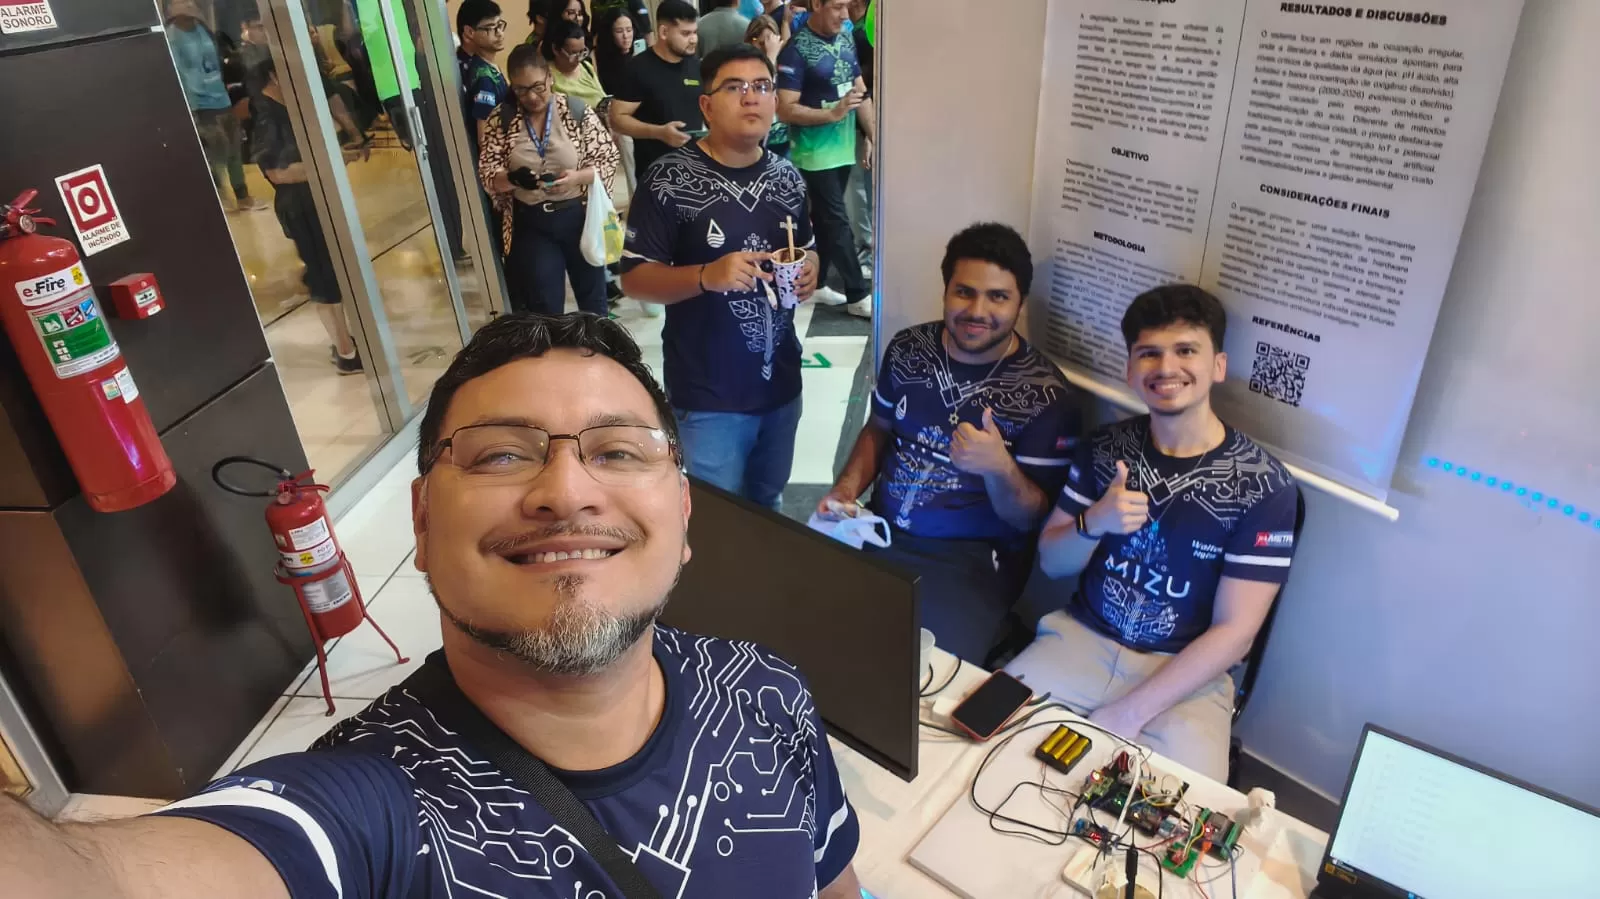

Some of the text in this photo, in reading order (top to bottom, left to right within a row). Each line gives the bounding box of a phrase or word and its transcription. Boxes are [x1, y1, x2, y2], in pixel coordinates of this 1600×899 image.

[1, 4, 48, 17] ALARME
[3, 15, 52, 28] SONORO
[1280, 2, 1447, 26] RESULTADOS E DISCUSSÕES
[1111, 146, 1149, 161] OBJETIVO
[1259, 183, 1390, 218] CONSIDERAÇÕES FINAIS
[82, 221, 121, 241] ALARME DE
[1093, 231, 1146, 253] METODOLOGIA
[1252, 316, 1321, 342] REFERÊNCIAS
[1104, 553, 1191, 598] MIZU
